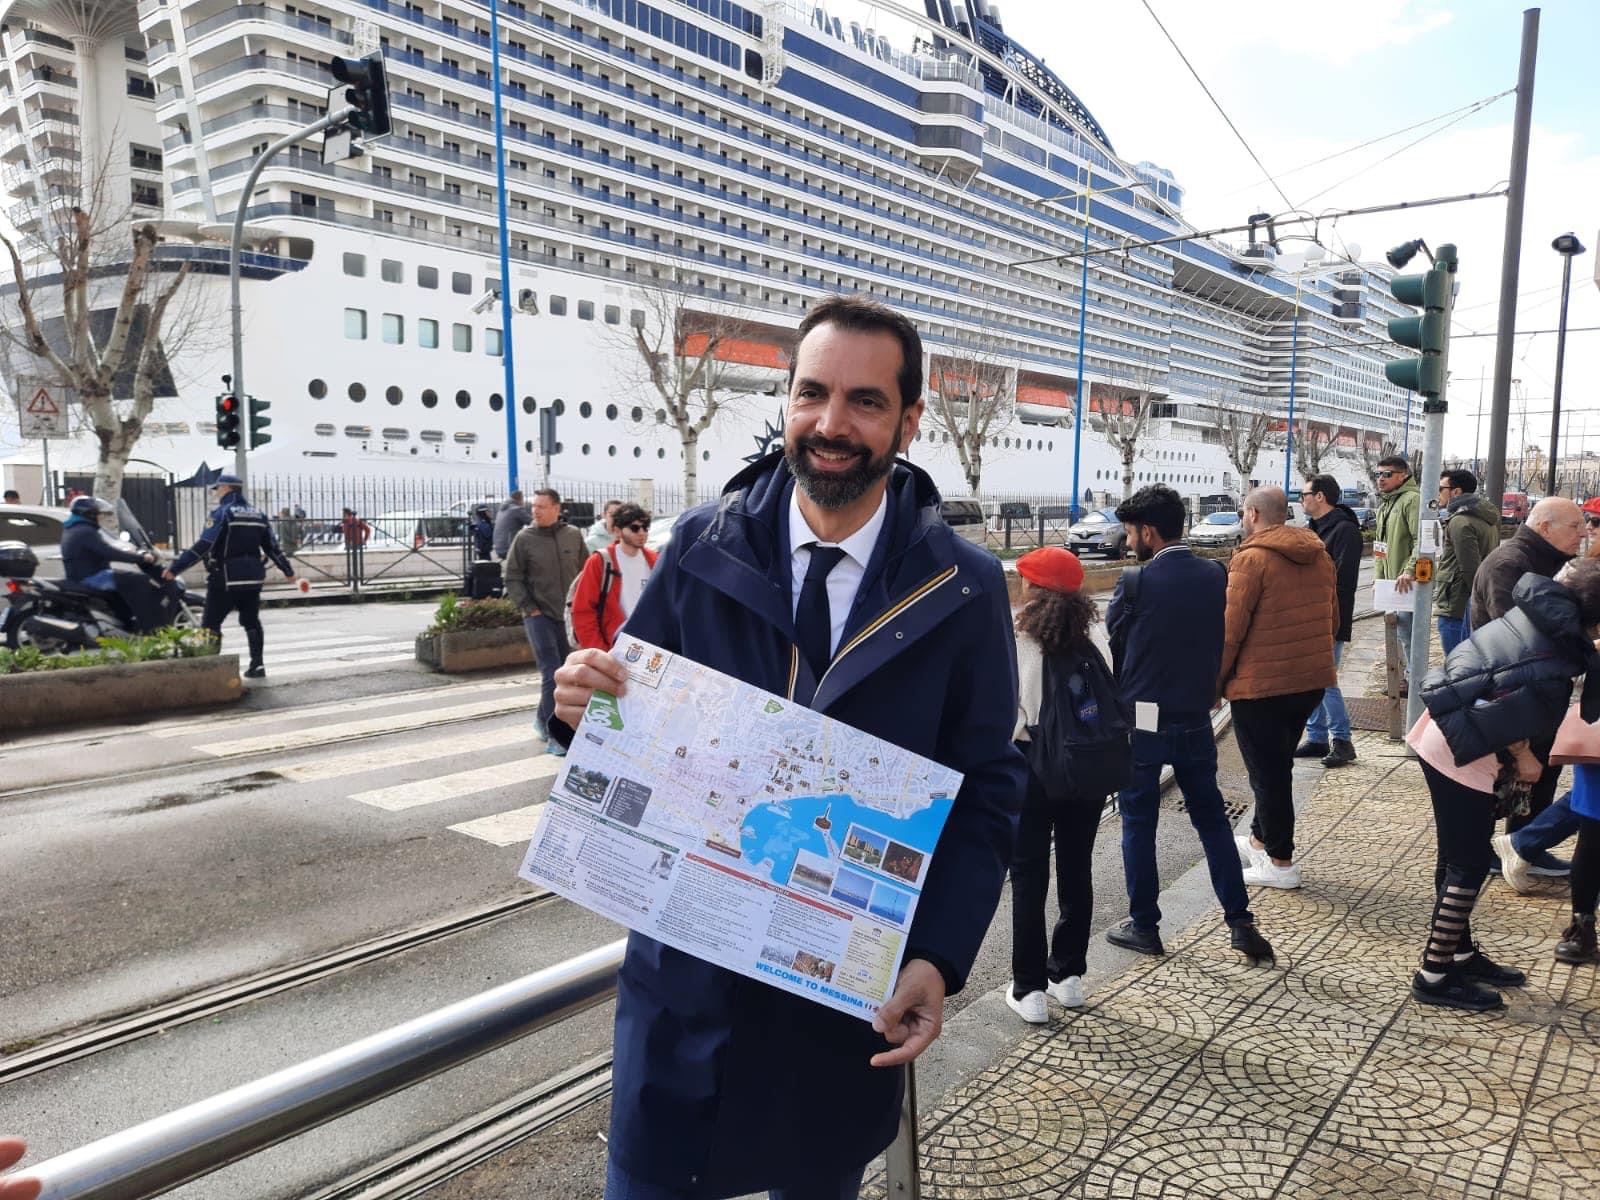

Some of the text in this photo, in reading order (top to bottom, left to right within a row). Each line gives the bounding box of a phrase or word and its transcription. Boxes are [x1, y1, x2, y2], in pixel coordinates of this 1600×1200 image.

[755, 961, 863, 1008] WELCOME TO MESSINA
